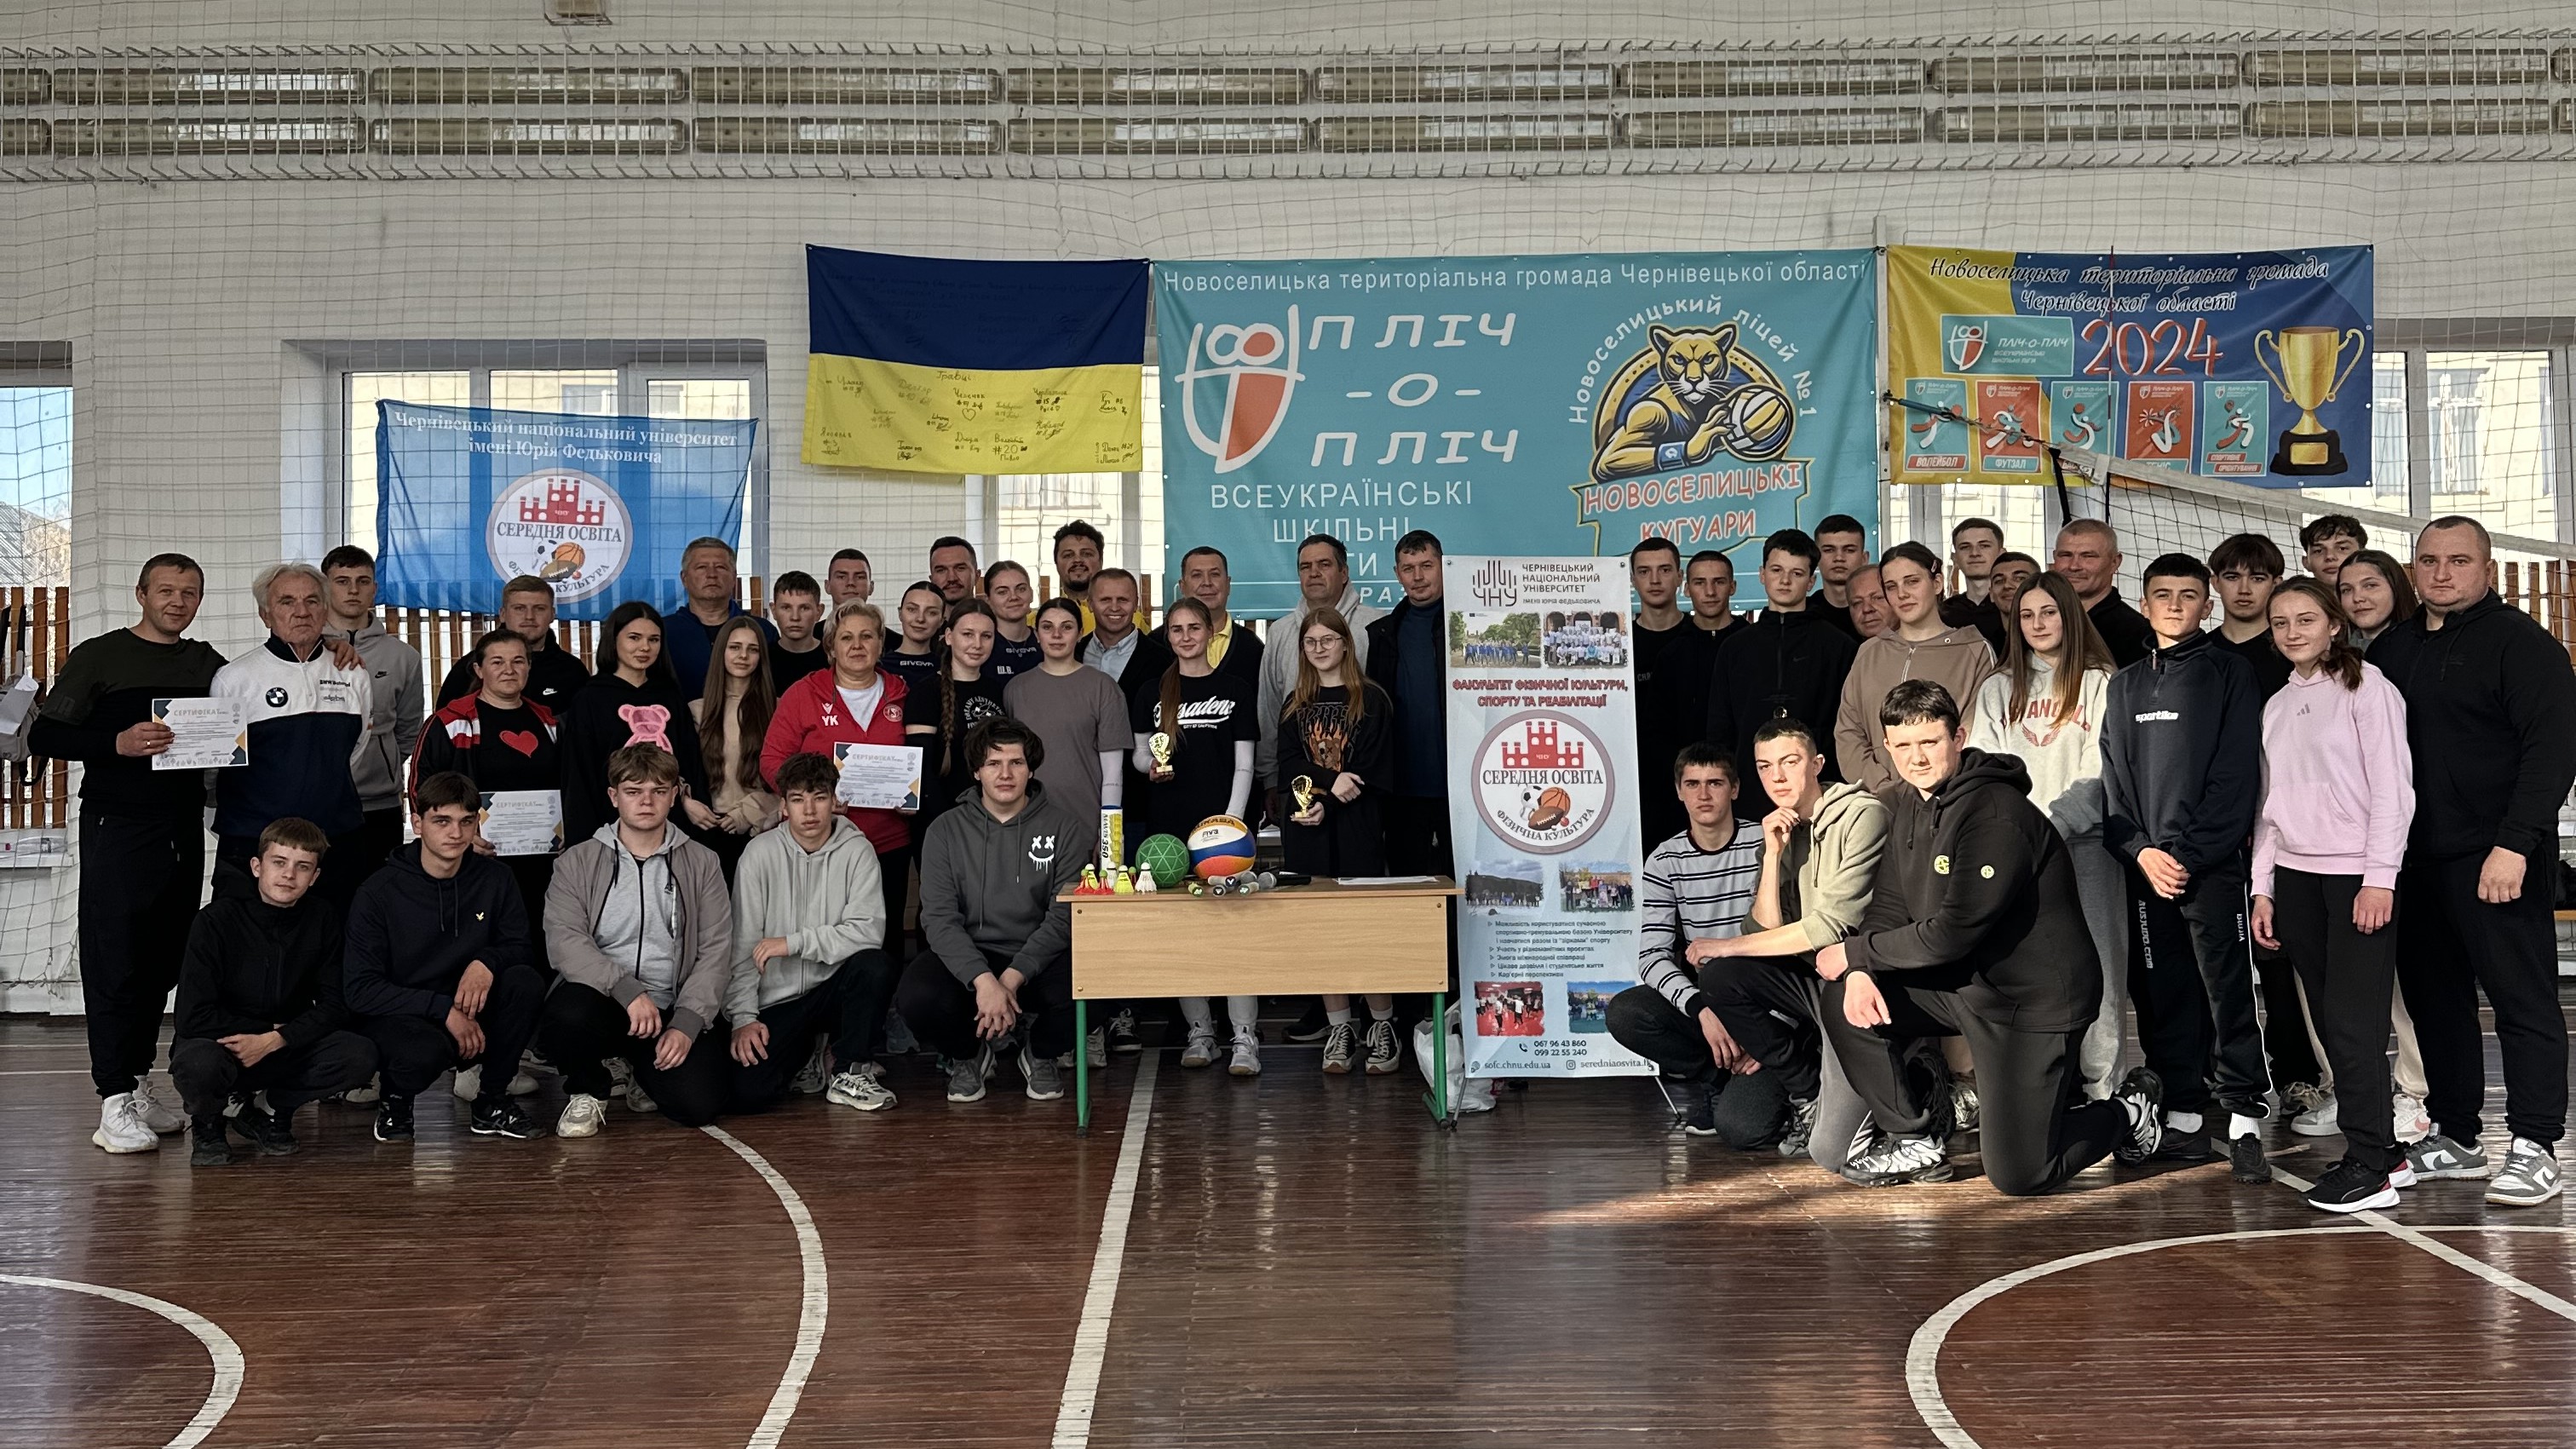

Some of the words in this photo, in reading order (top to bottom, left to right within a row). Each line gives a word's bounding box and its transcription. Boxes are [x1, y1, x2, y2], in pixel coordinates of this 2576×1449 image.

[1164, 271, 1330, 293] Новоселицька
[1340, 267, 1507, 293] територіальна
[1517, 268, 1612, 290] громада
[1621, 262, 1773, 288] Чернівецької
[1780, 261, 1866, 282] області
[1929, 257, 2070, 288] Новоселицька
[2245, 256, 2330, 290] громада
[2021, 289, 2150, 319] Чернівецької
[2156, 286, 2238, 313] області
[1568, 294, 1722, 423] Новоселицький
[1732, 308, 1800, 363] ліцей
[2081, 318, 2225, 378] 2024
[394, 411, 513, 433] Чернівецький
[517, 422, 635, 441] національний
[639, 428, 738, 446] університет
[469, 438, 511, 455] імені
[515, 440, 558, 460] Юрія
[563, 444, 662, 464] Федьковича
[1916, 457, 1958, 468] ВОЛЕЙБОЛ
[1995, 458, 2027, 469] ФУТЗАЛ
[1211, 480, 1472, 509] ВСЕУКРАЇНСЬКІ
[1584, 463, 1802, 515] НОВОСЕЛИЦЬКІ
[497, 522, 565, 540] СЕРЕДНЯ
[568, 526, 622, 543] ОСВІТА
[1641, 509, 1757, 544] КУГУАРИ
[555, 564, 609, 593] КУЛЬТУРА
[1522, 563, 1594, 573] ЧЕРНІВЕЦЬКИЙ
[1522, 573, 1601, 584] НАЦІОНАЛЬНИЙ
[1523, 584, 1585, 593] УНІВЕРСИТЕТ
[1452, 679, 1513, 690] ФАКУЛЬТЕТ
[1515, 678, 1569, 690] ФІЗИЧНОЇ
[1571, 679, 1629, 692] КУЛЬТУРИ,
[1477, 696, 1521, 707] СПОРТУ
[1522, 696, 1536, 706] ТА
[1538, 693, 1607, 708] РЕАБІЛІТАЦІЇ
[821, 716, 839, 726] YK
[1483, 769, 1549, 787] СЕРЕДНЯ
[1551, 770, 1603, 785] ОСВІТА
[1497, 809, 1543, 841] ФІЗИЧНА
[1544, 808, 1596, 841] КУЛЬТУРА
